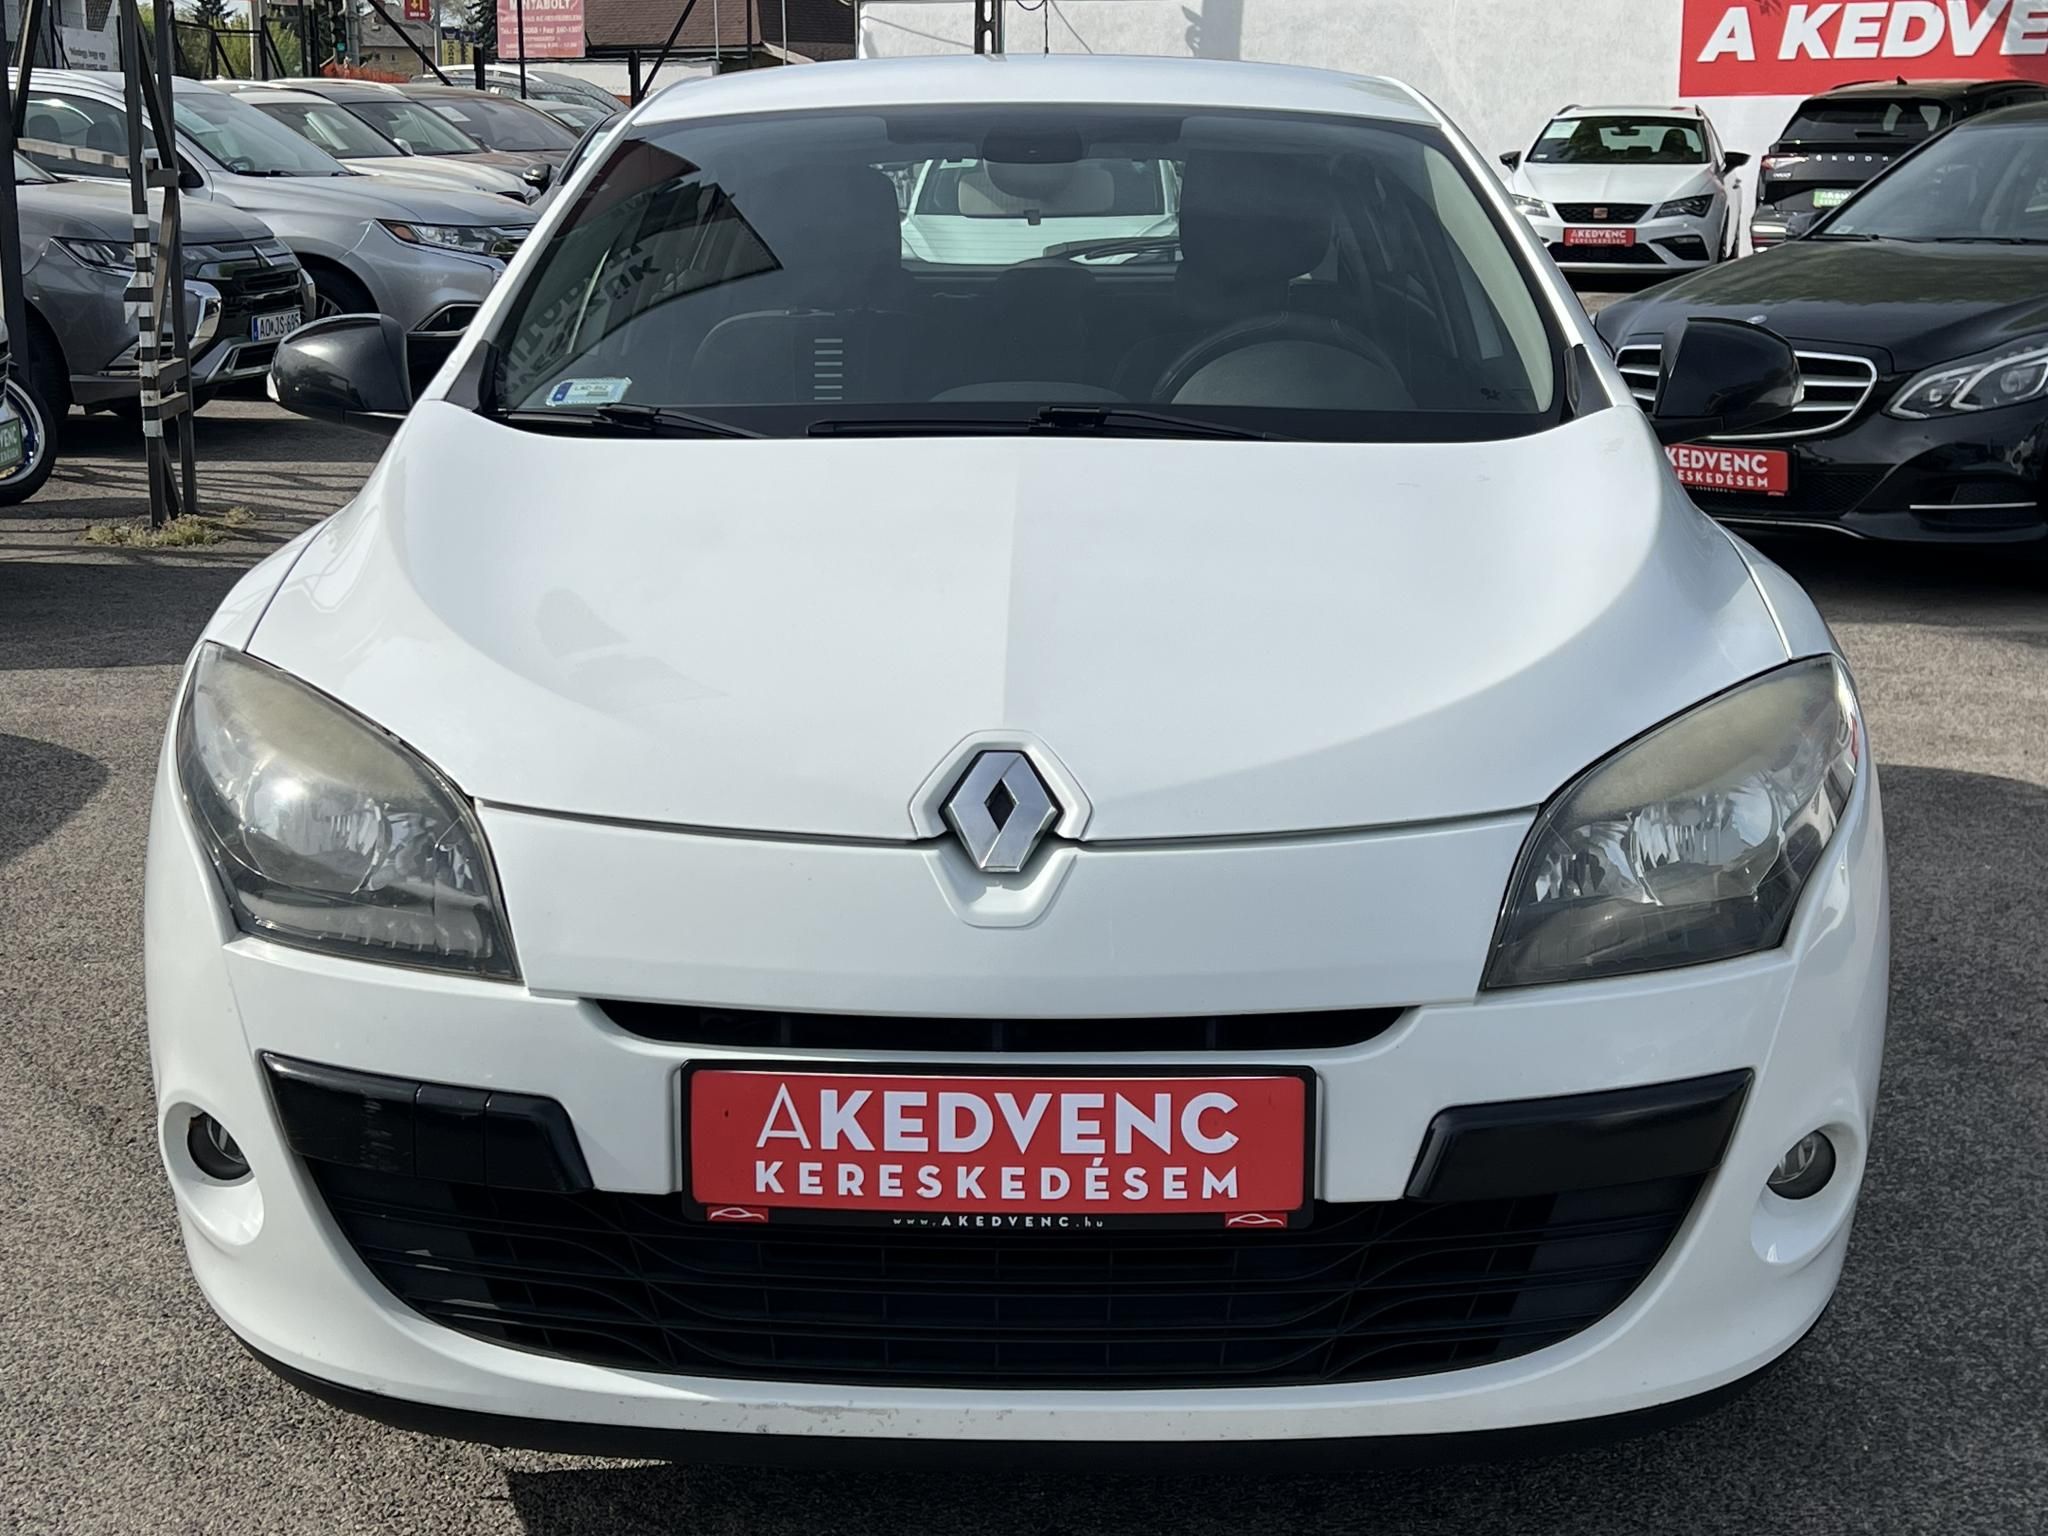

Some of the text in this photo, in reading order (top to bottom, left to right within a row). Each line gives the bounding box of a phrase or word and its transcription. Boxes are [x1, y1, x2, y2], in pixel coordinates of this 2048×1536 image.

[1697, 0, 2048, 62] A KEDVE
[755, 1082, 1239, 1155] AKEDVENC
[755, 1157, 1238, 1201] KERESKEDÉSEM
[893, 1215, 1103, 1228] www.AKEDVENC.hu
